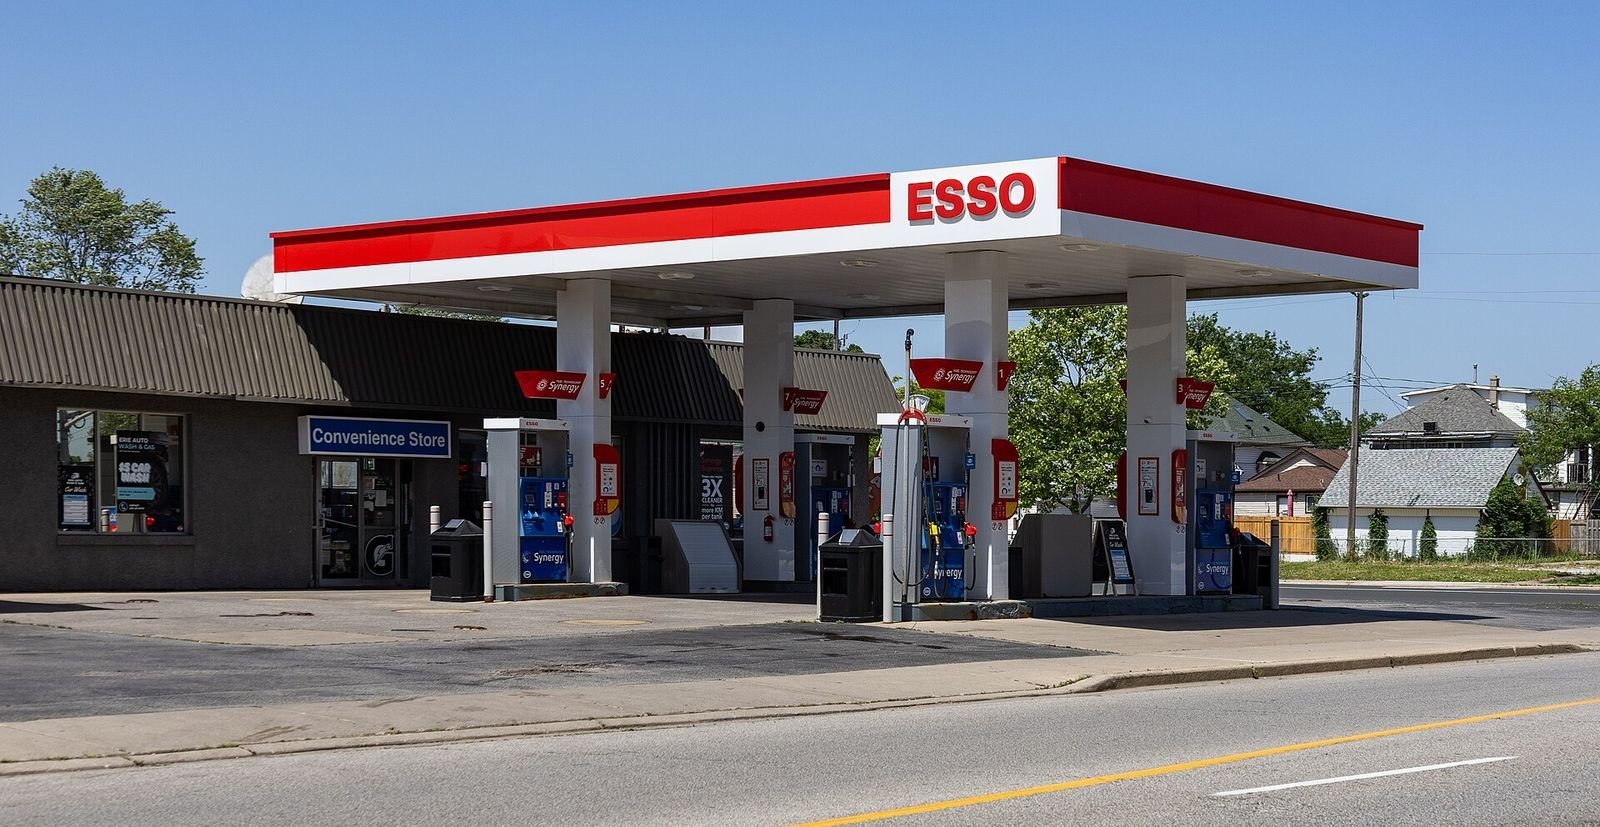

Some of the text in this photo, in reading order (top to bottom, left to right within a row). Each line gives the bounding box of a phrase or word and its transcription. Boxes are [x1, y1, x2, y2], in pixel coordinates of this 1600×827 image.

[908, 172, 1036, 222] ESSO
[945, 370, 976, 384] Synergy
[998, 369, 1004, 378] 1
[548, 381, 580, 393] Synergy
[600, 379, 605, 388] 5
[1178, 383, 1184, 393] 3
[785, 392, 790, 401] 7
[794, 398, 820, 409] Synergy
[312, 427, 446, 448] Convenience Store
[130, 462, 152, 473] CAR
[120, 472, 150, 483] WASH
[702, 478, 723, 498] 3X
[714, 506, 723, 514] KM
[533, 552, 564, 565] Synergy
[1206, 563, 1229, 576] Synergy
